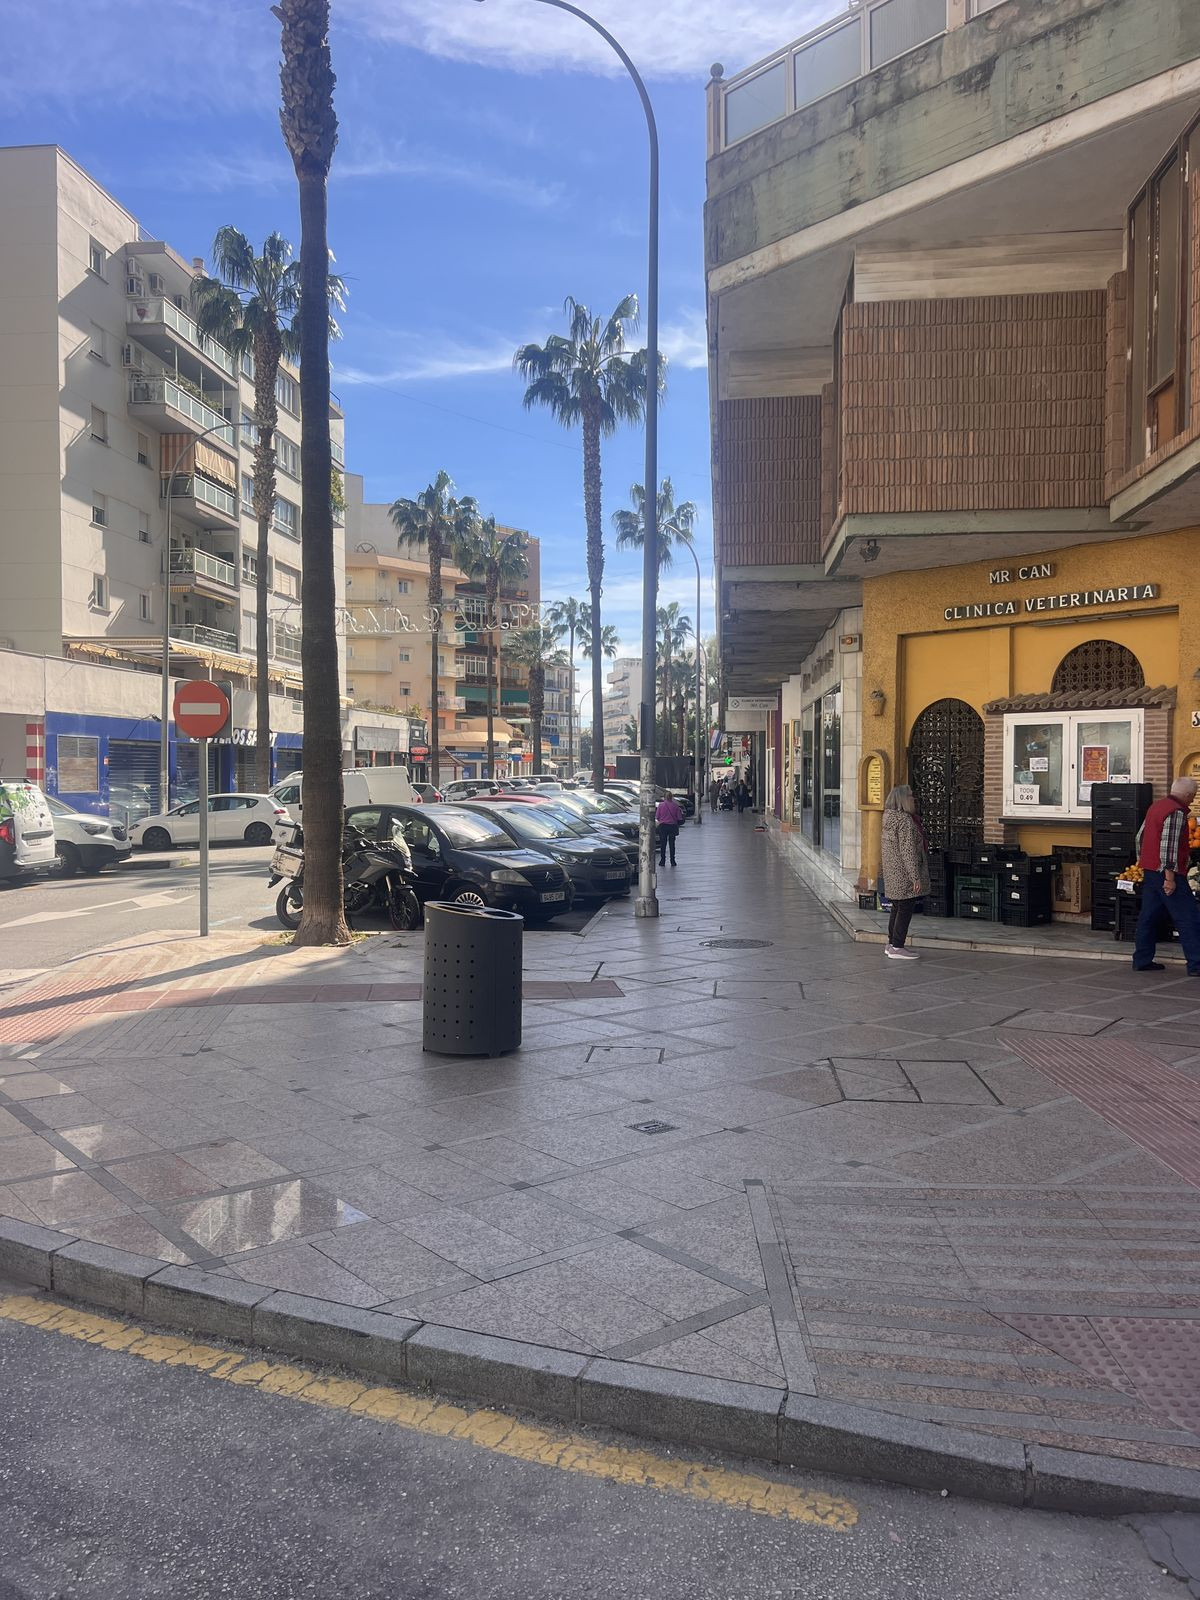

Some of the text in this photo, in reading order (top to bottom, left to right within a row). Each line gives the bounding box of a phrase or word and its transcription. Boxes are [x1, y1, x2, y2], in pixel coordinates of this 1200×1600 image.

[989, 563, 1051, 584] MR CAN
[944, 585, 1154, 620] CLINICA VETERINARIA
